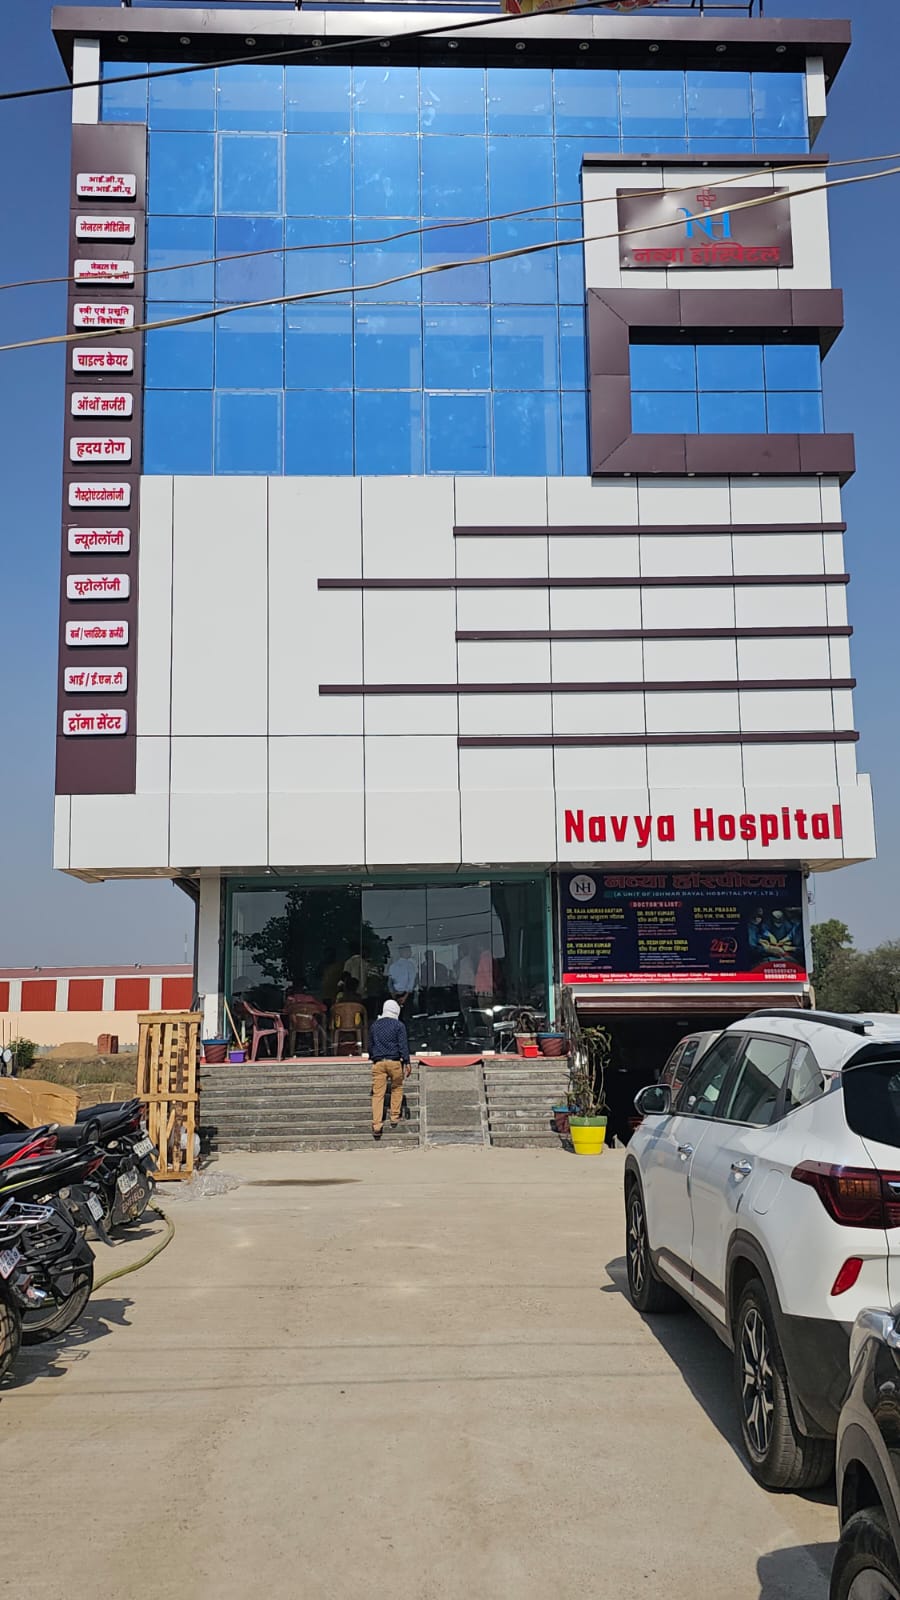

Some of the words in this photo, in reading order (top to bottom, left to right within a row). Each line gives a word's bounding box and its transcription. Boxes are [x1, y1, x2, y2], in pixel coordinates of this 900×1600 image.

[632, 247, 685, 263] नव्या
[78, 354, 104, 367] चाइल्ड
[106, 352, 128, 366] केयर
[101, 396, 126, 411] सर्जरी
[104, 439, 125, 454] रोग
[74, 531, 124, 549] न्यूरोलॉजी
[74, 577, 120, 595] यूरोलॉजी
[68, 713, 94, 732] ट्रॉमा
[96, 713, 121, 730] सेंटर
[564, 810, 675, 848] Navya
[693, 804, 843, 847] Hospital
[604, 875, 668, 888] नव्या
